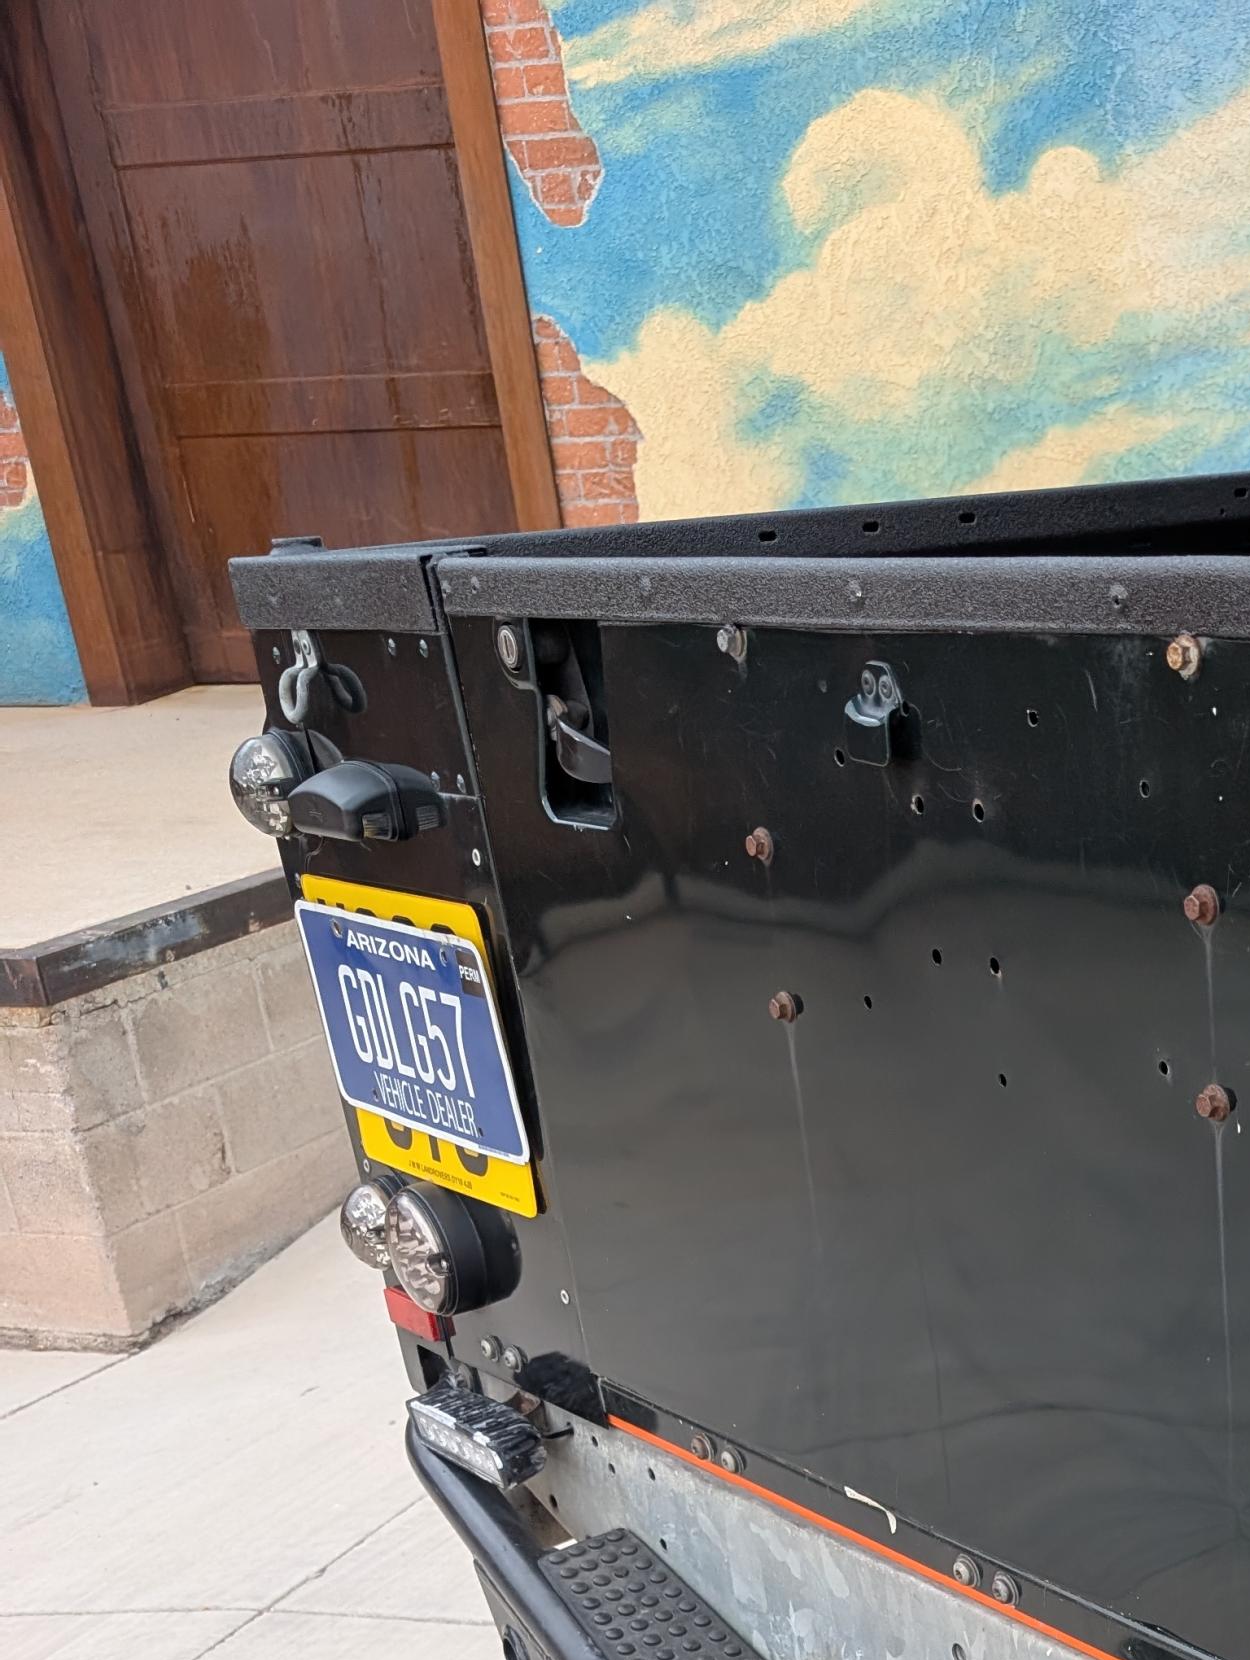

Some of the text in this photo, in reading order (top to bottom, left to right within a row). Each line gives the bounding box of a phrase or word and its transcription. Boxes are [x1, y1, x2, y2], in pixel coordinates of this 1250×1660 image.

[347, 929, 436, 971] ARIZONA
[459, 963, 480, 985] PERM
[338, 963, 475, 1099] GDLG57
[374, 1070, 479, 1138] VEHICLE DEALER
